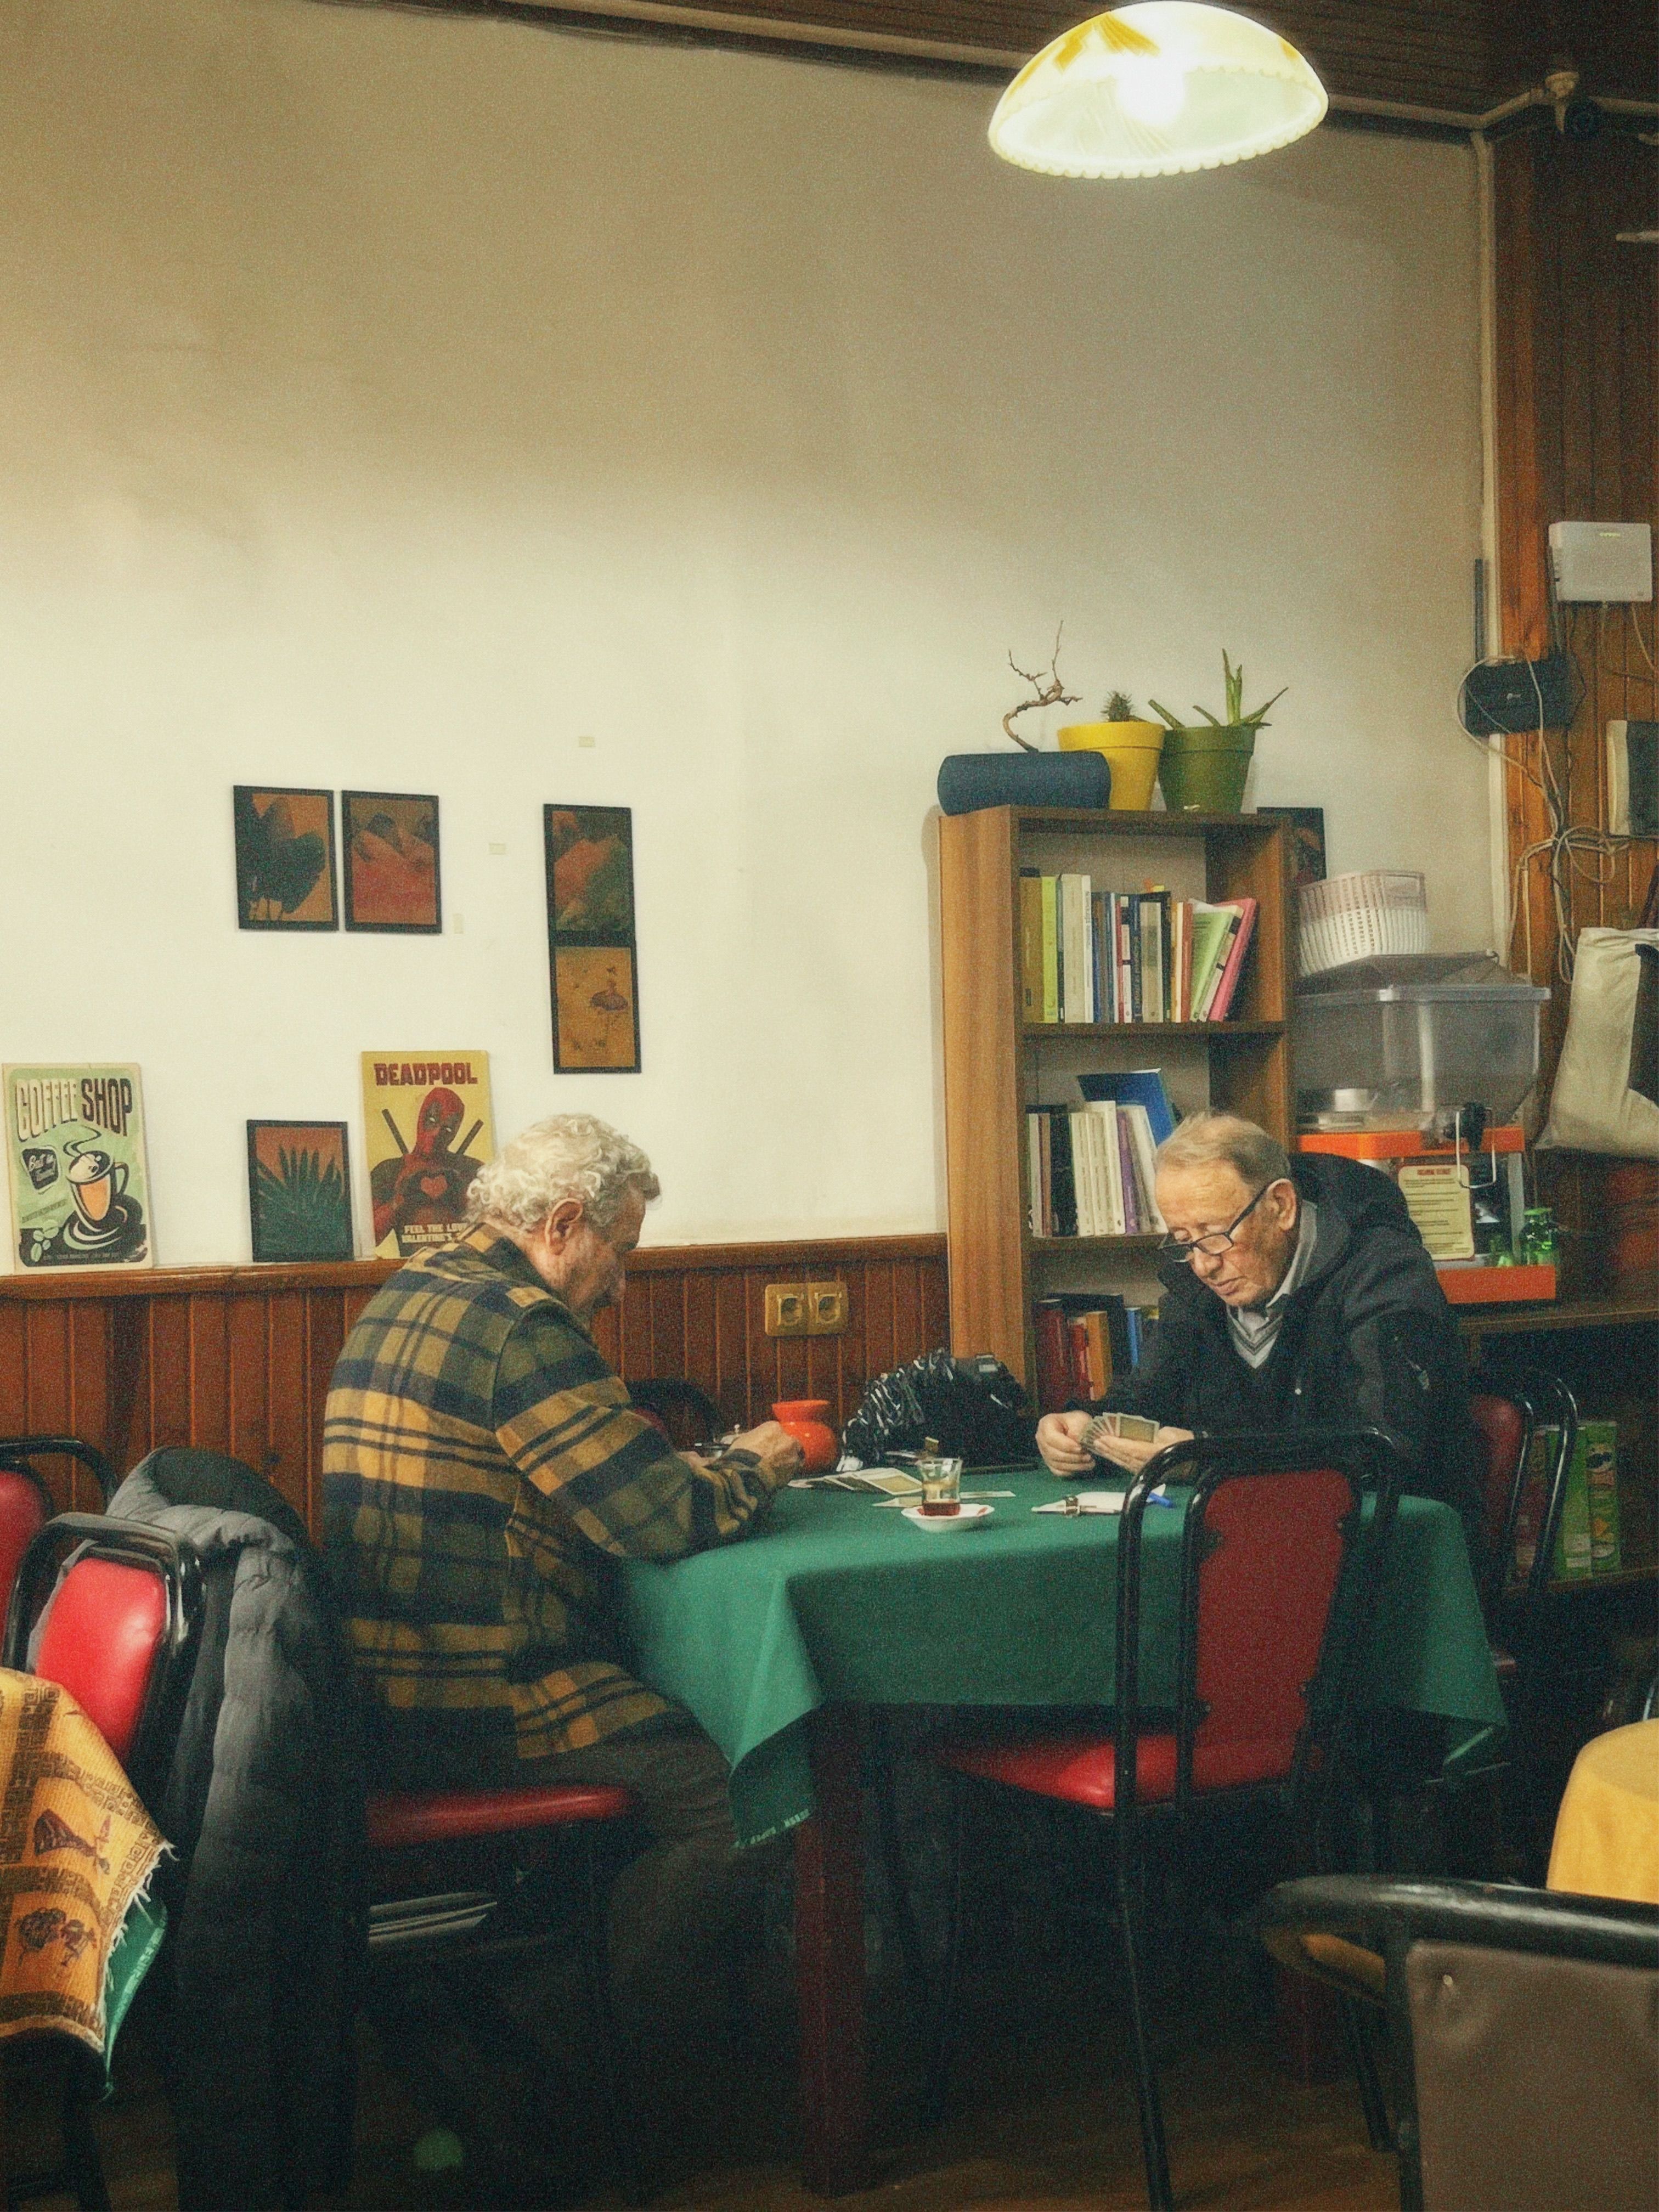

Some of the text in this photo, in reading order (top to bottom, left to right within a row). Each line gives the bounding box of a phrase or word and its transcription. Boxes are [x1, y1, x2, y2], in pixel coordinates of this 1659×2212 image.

[374, 1063, 478, 1086] DEADPOOL
[15, 1078, 132, 1142] COFFEE SHOP
